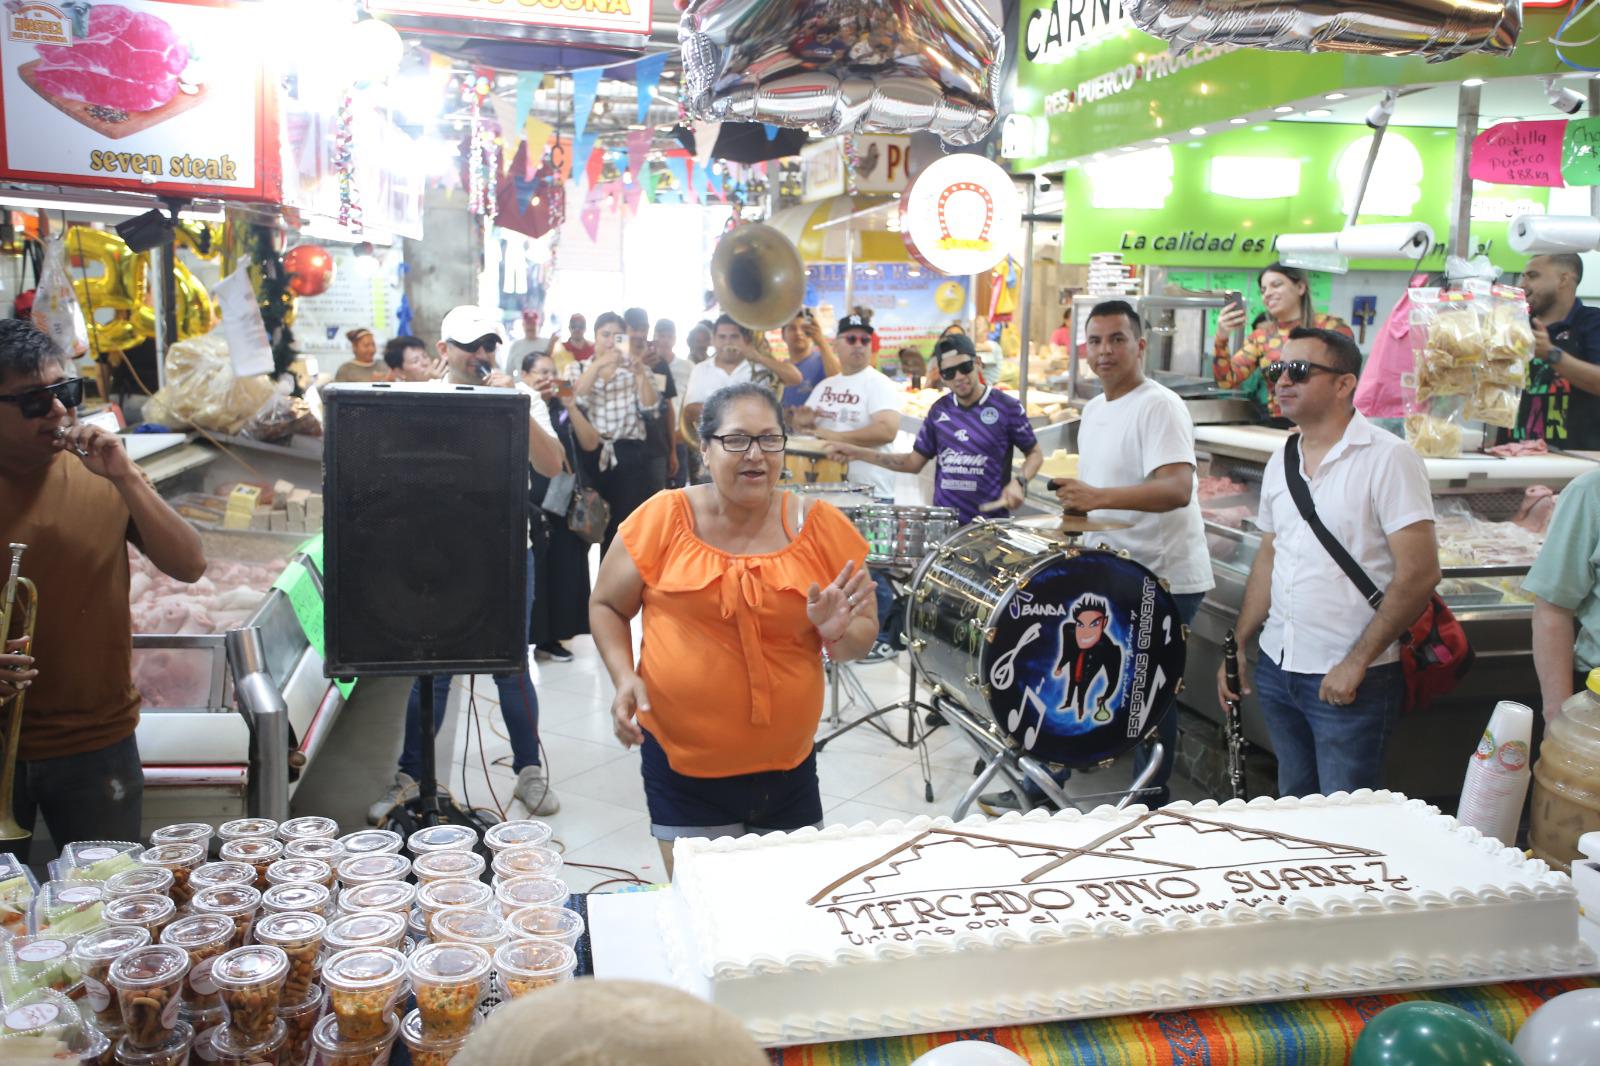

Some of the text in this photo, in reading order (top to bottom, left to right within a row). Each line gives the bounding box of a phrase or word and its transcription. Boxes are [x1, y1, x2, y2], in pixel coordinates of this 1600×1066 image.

[1077, 63, 1136, 103] PUERCO
[90, 149, 237, 181] seven steak
[1121, 232, 1147, 250] La
[1152, 231, 1237, 251] calidad
[1241, 238, 1266, 252] es
[1021, 604, 1067, 617] BANDA
[1127, 577, 1157, 738] JUVENTUD SINALOENSE
[827, 860, 1408, 935] MERCADO PINO SUAREZ
[966, 916, 1010, 931] por
[1030, 910, 1060, 923] el
